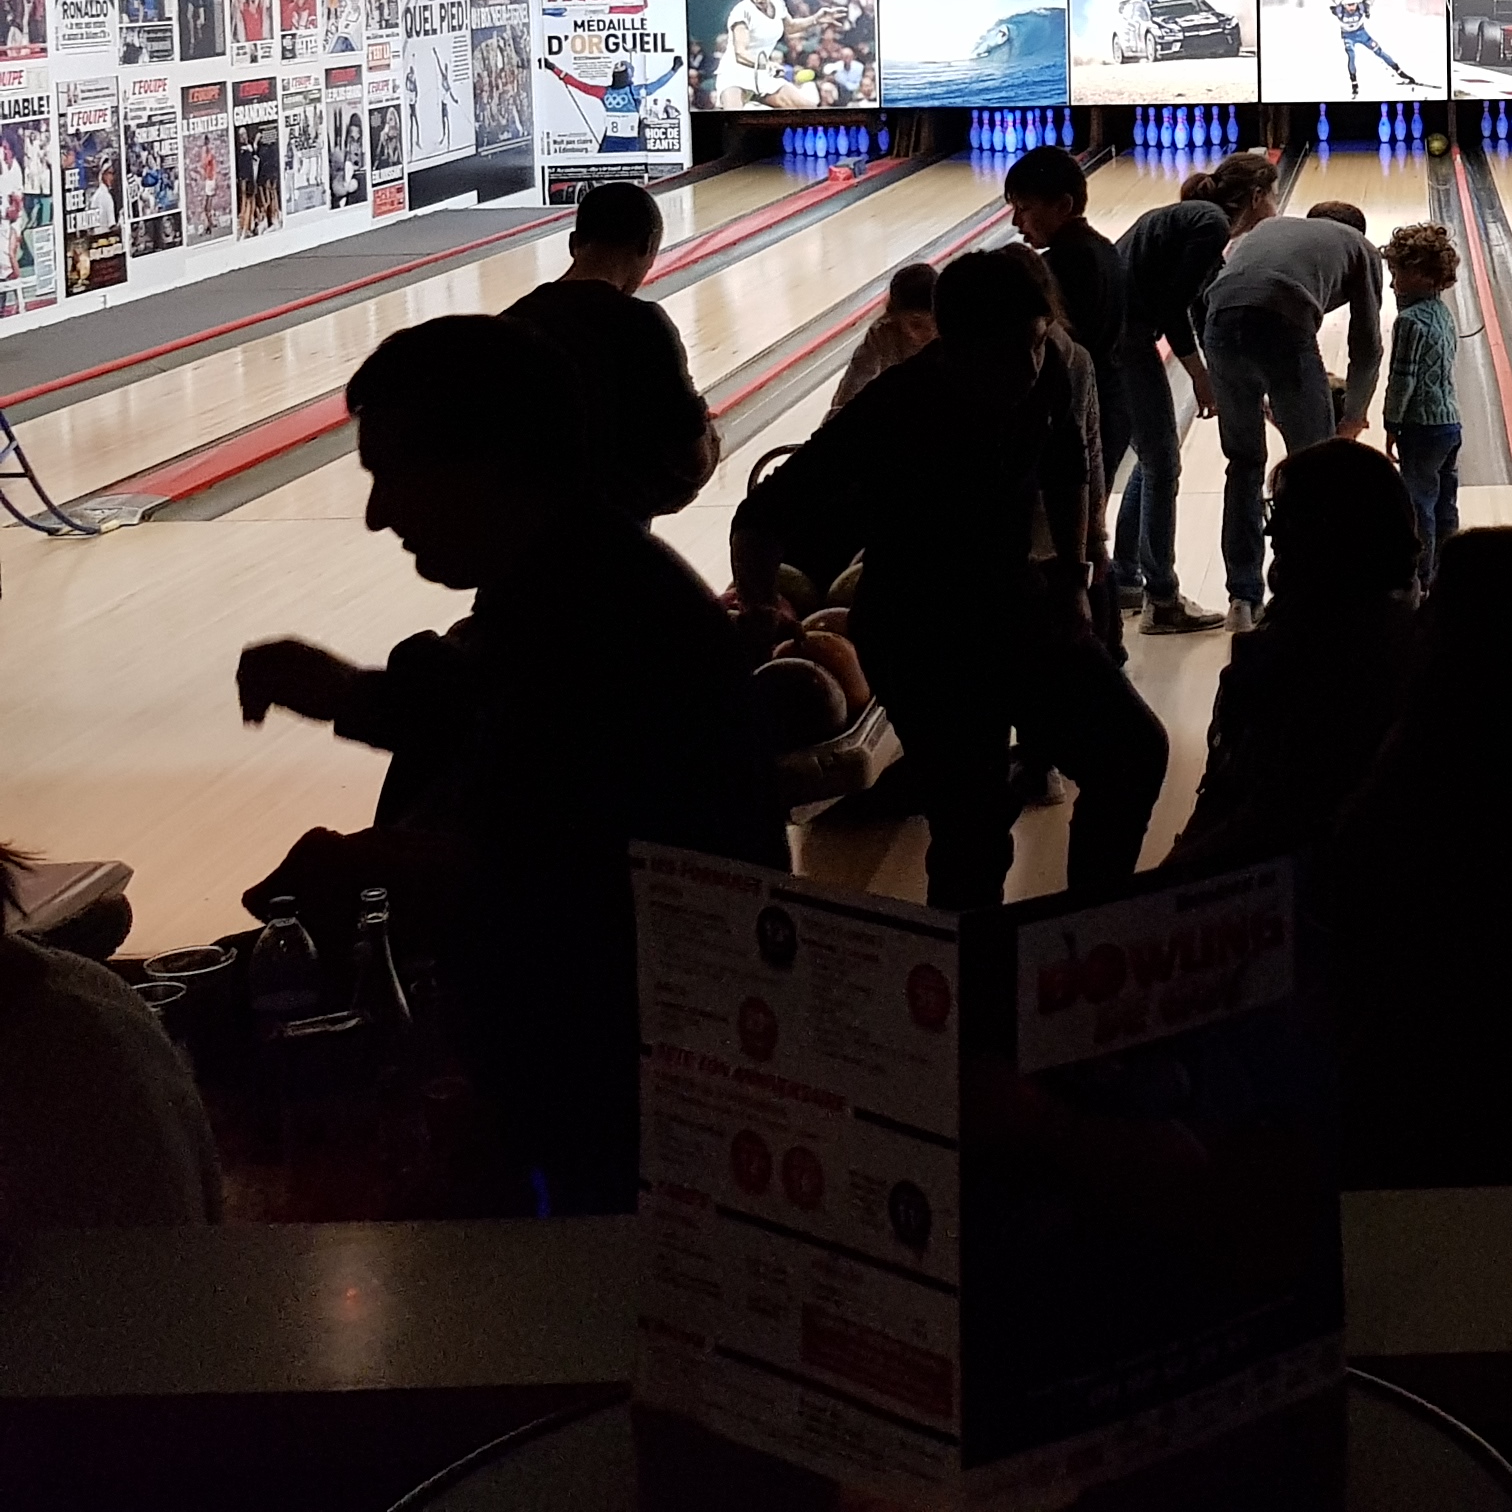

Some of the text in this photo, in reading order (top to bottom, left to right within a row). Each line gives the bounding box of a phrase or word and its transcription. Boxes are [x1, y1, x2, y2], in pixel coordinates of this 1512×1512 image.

[62, 0, 109, 19] RONALDO
[405, 2, 437, 39] QUEL
[547, 33, 675, 56] D'ORGUEIL
[611, 121, 618, 134] 8
[667, 127, 679, 137] DE
